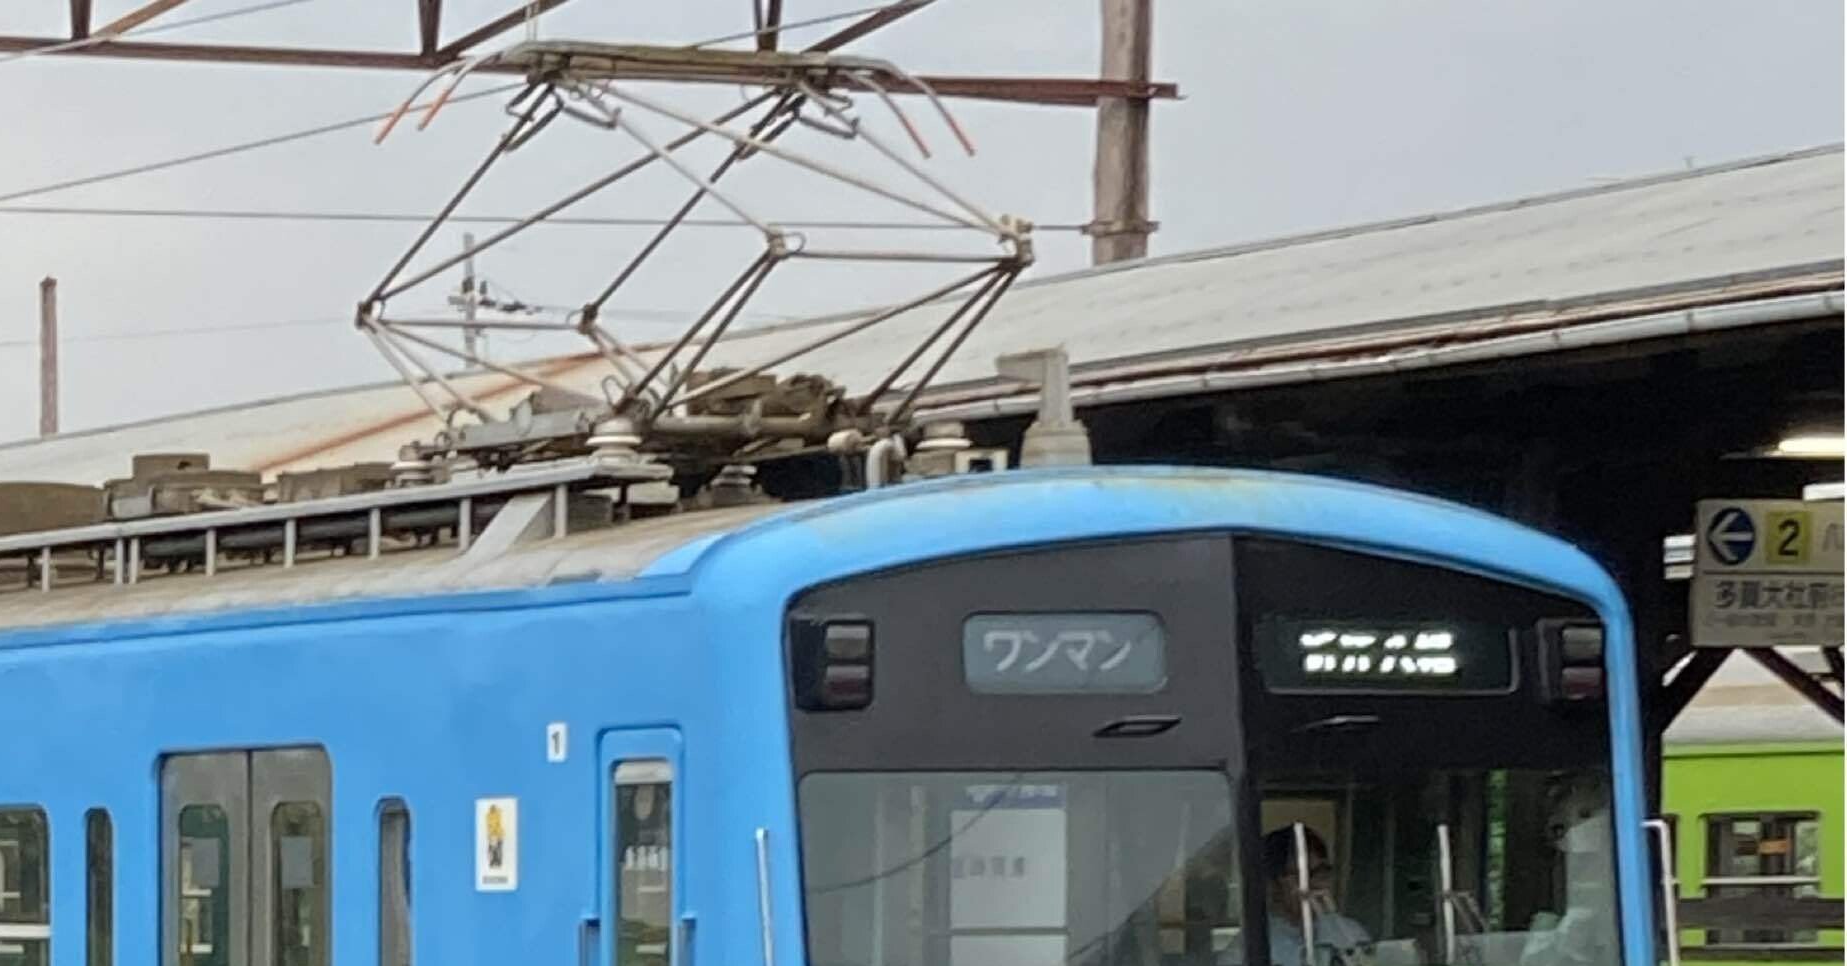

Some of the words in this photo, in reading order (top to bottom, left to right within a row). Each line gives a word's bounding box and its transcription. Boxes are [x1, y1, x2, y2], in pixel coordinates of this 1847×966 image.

[1778, 518, 1800, 557] 2
[983, 629, 1132, 673] ワンマン
[551, 730, 560, 755] 1
